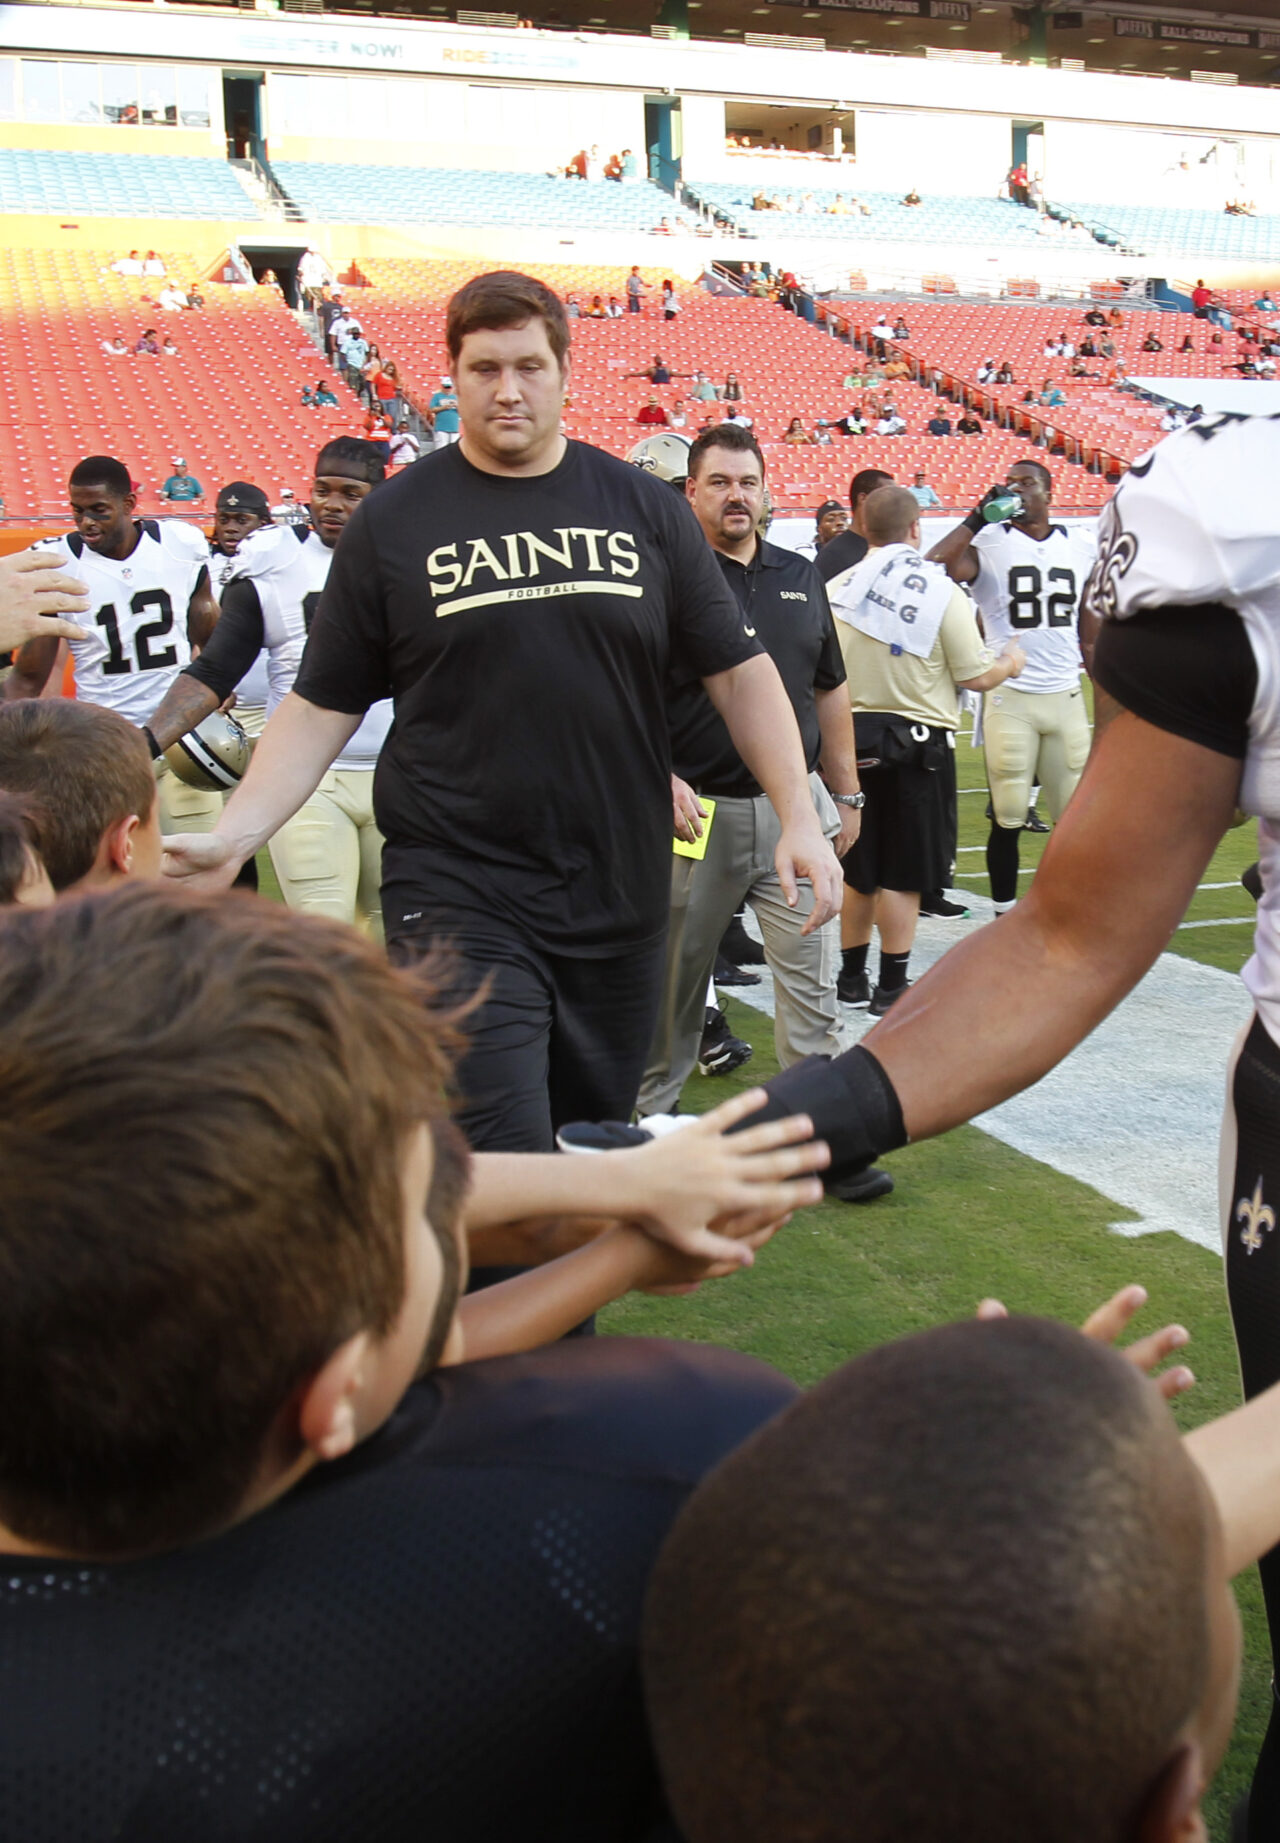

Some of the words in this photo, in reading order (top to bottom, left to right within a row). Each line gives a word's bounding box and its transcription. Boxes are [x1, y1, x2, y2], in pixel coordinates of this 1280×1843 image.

[427, 527, 640, 597] SAINTS
[508, 583, 579, 600] FOOTBALL
[780, 591, 808, 602] SAINTS
[1008, 565, 1077, 629] 82
[95, 588, 179, 676] 12
